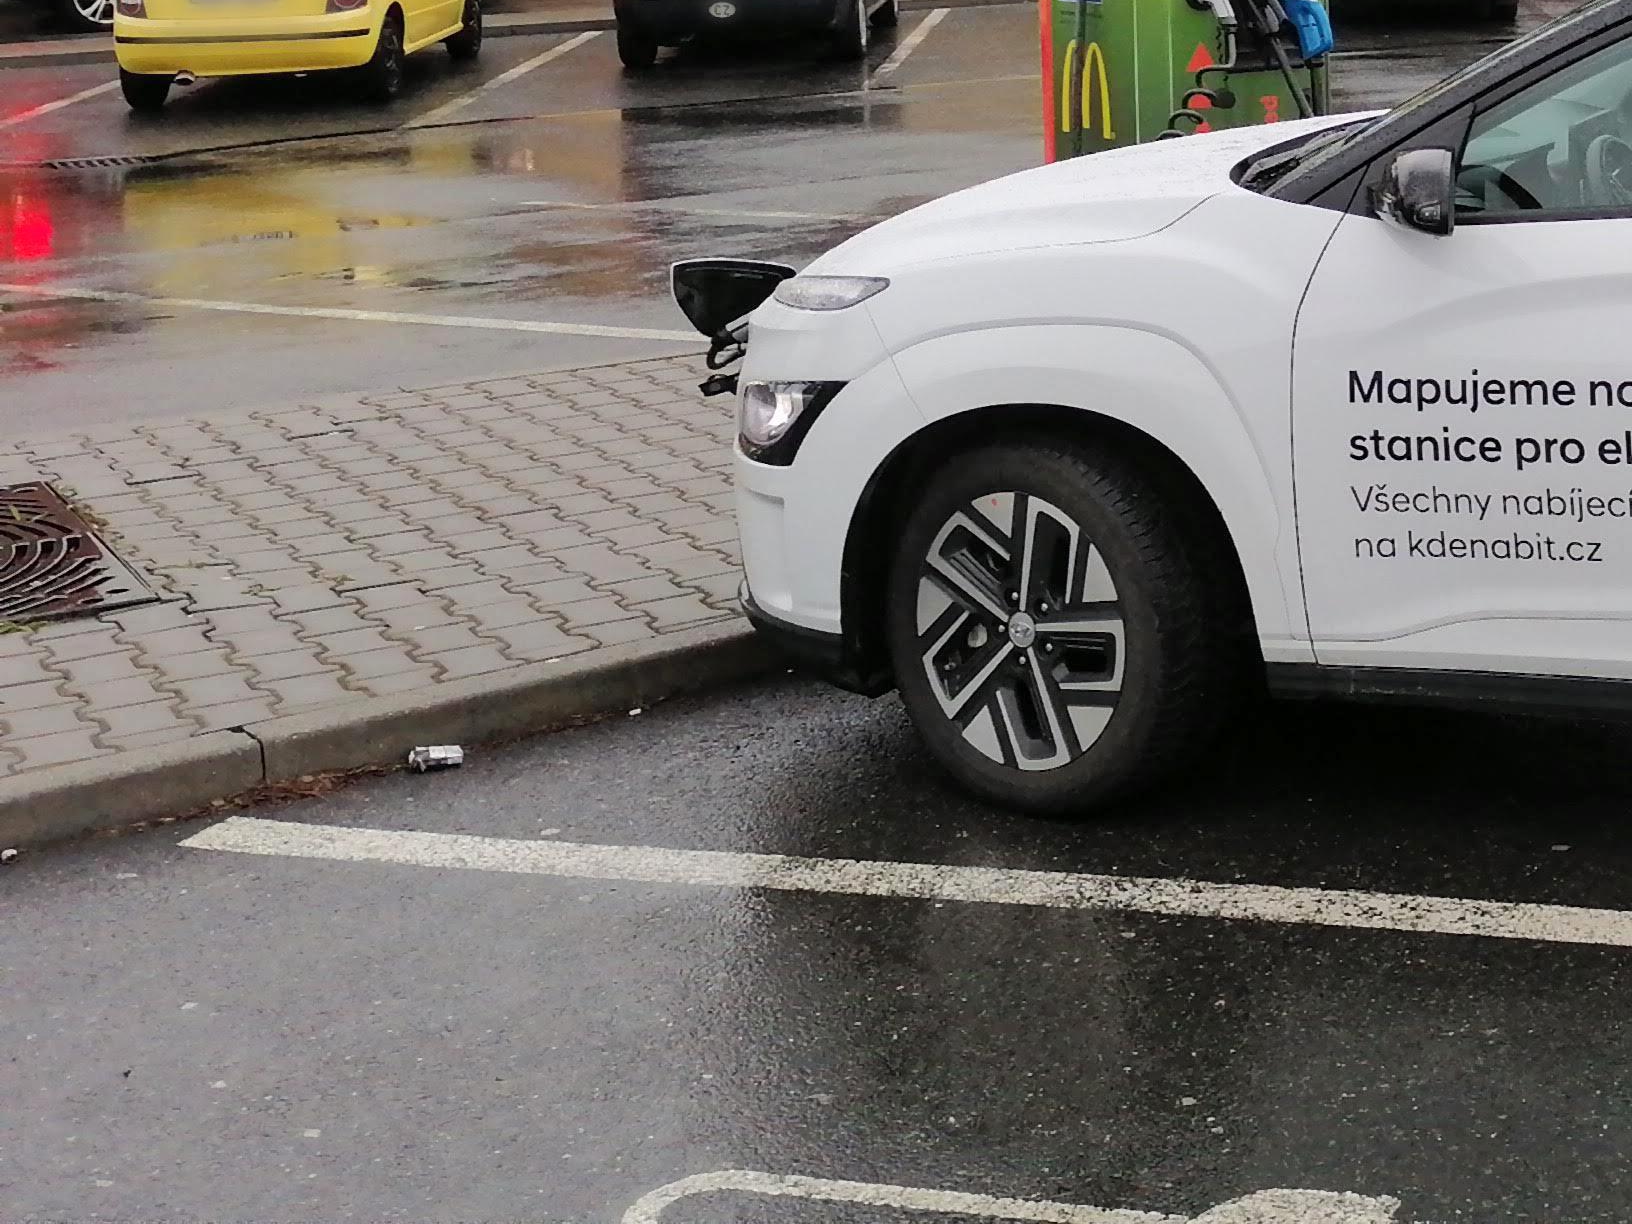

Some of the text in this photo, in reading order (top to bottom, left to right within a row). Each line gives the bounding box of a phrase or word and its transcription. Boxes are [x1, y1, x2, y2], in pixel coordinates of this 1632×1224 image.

[1349, 369, 1577, 413] Mapujeme
[1350, 426, 1502, 463] stanice
[1515, 437, 1586, 471] pro
[1350, 483, 1492, 521] Všechny
[1354, 530, 1604, 562] na kdenabit.cz
